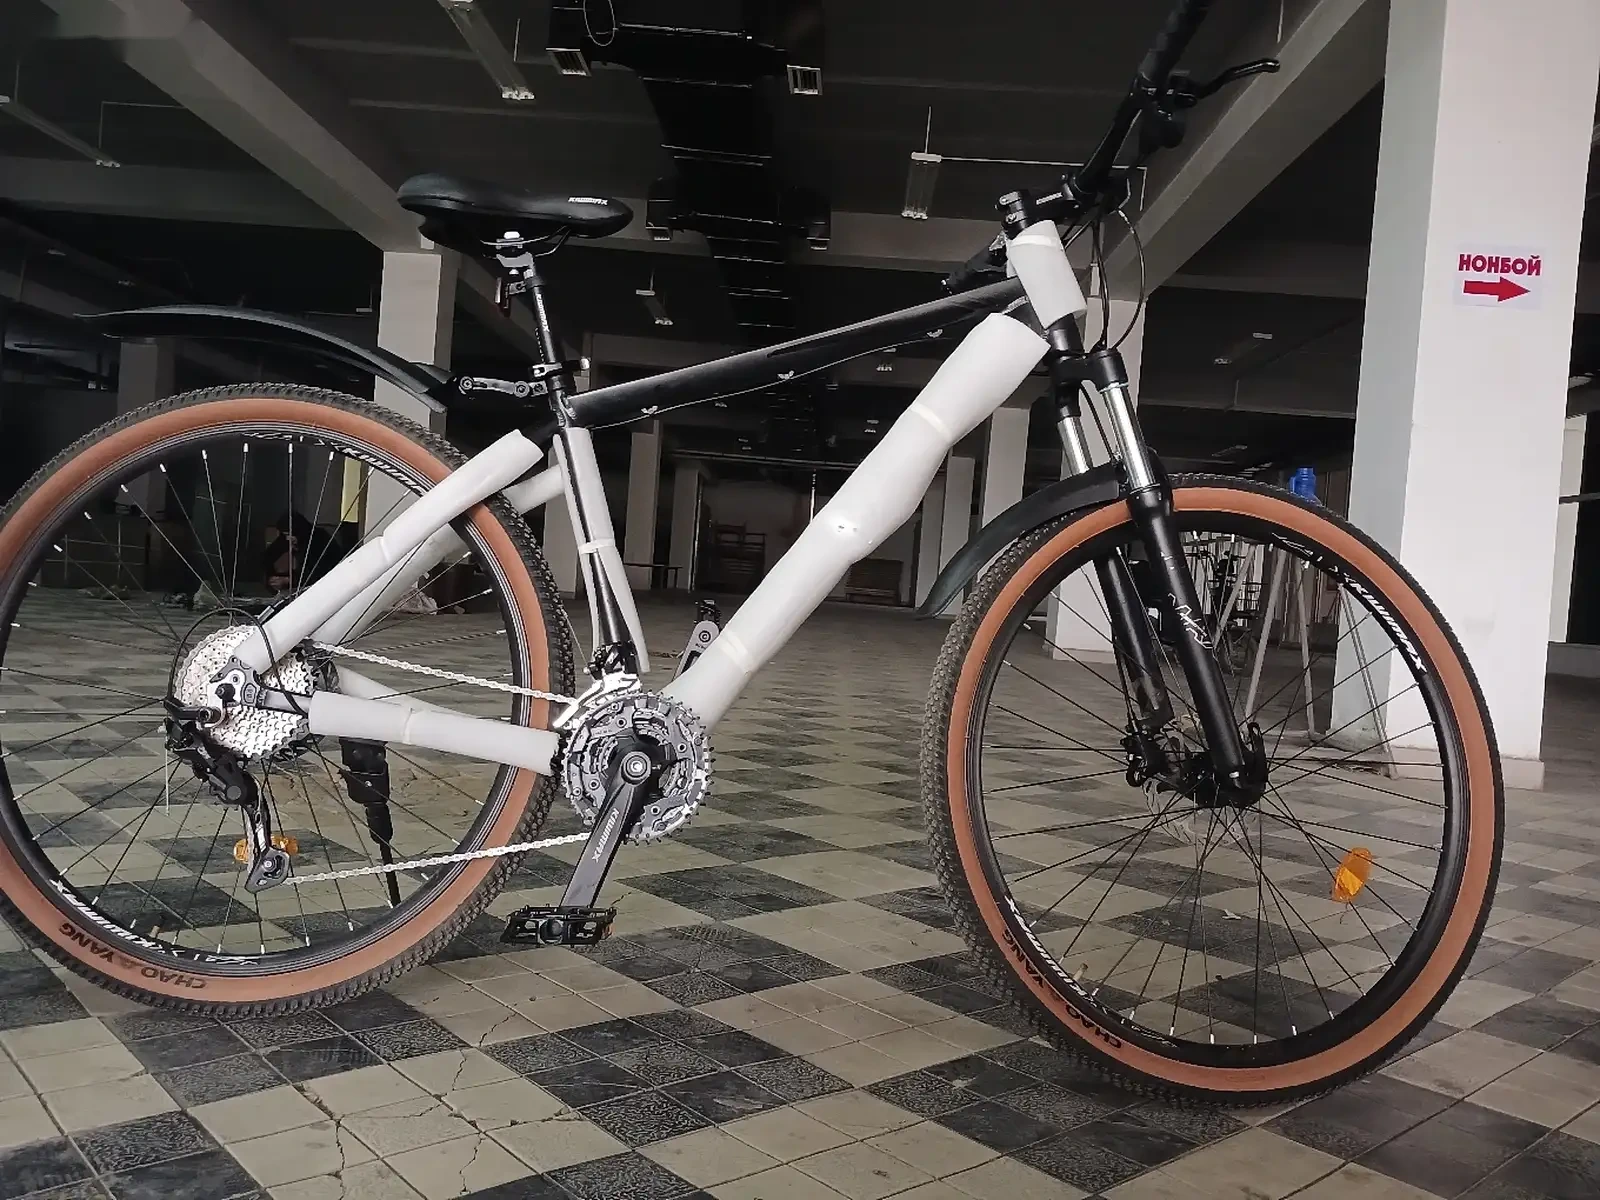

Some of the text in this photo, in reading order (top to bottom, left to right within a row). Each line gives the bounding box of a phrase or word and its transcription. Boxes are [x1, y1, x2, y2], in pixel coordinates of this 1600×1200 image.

[1458, 254, 1542, 276] НОНБОЙ
[59, 922, 207, 989] CHAO YANG
[1002, 928, 1122, 1049] CHAO YANG
